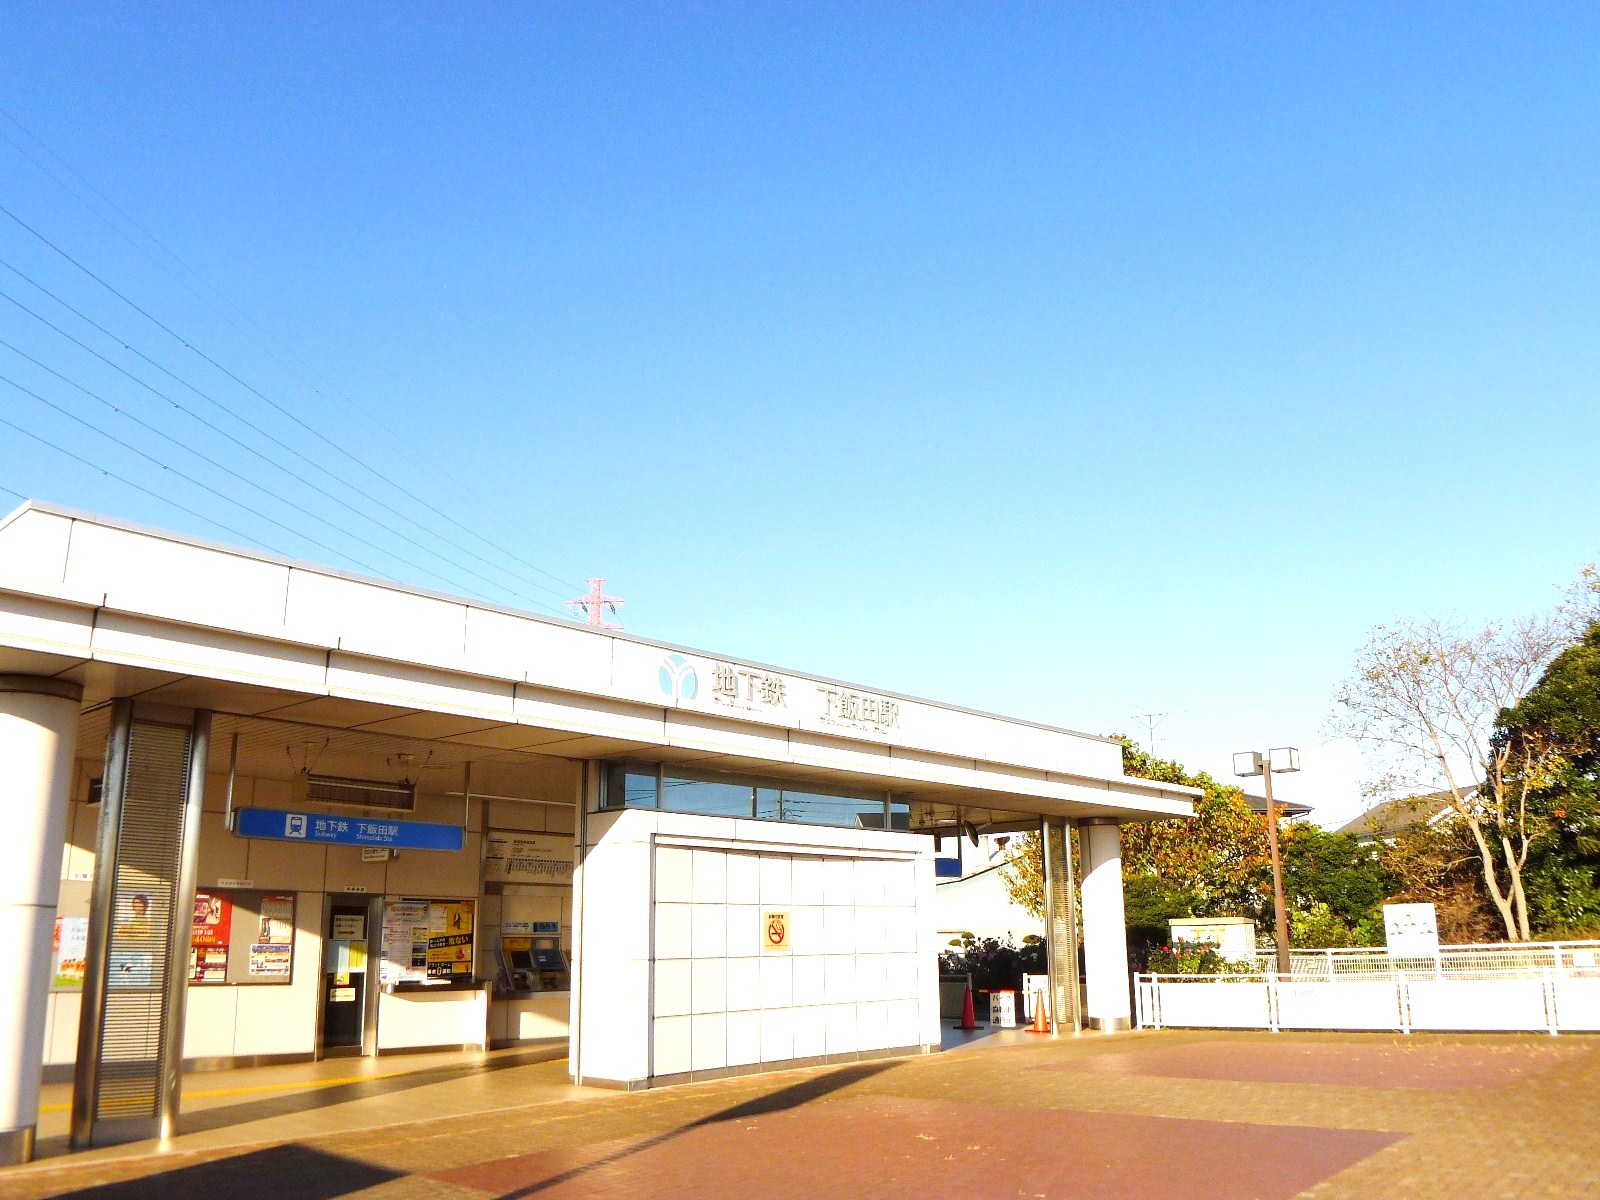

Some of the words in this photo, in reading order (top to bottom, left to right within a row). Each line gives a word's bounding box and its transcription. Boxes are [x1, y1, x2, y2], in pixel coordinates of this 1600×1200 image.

[711, 662, 788, 708] 地下鉄
[816, 685, 901, 730] 下飯田駅
[314, 830, 337, 839] Subway
[315, 819, 349, 832] 地下鉄
[357, 823, 399, 836] 下飯田駅
